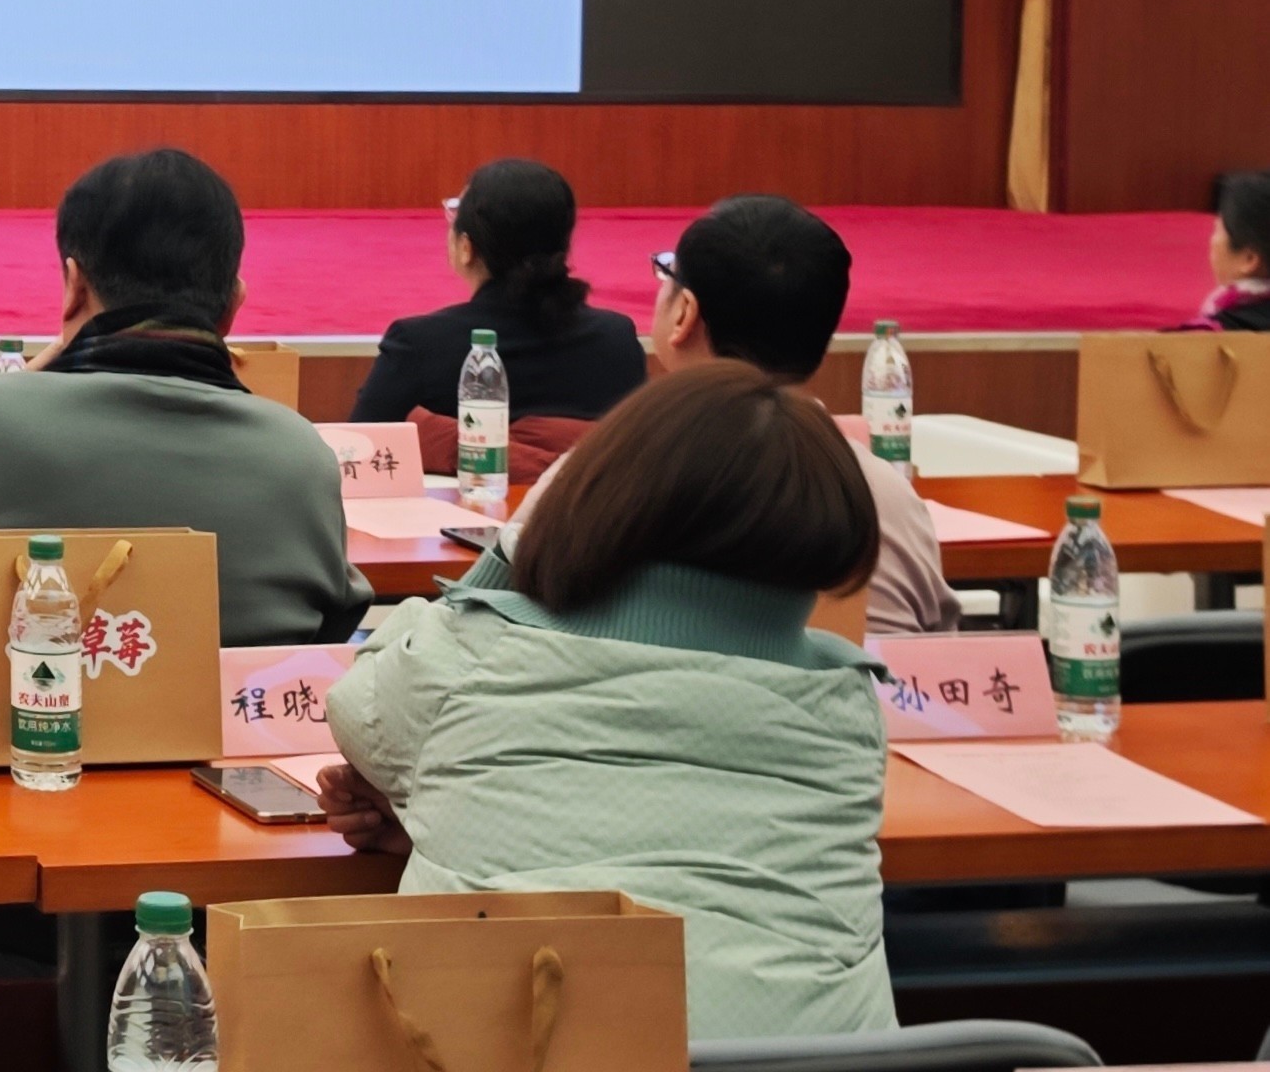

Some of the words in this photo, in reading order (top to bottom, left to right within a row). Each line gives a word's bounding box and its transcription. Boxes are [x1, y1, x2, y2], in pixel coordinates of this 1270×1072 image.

[80, 615, 151, 672] 草莓
[890, 667, 1021, 715] 孙田奇
